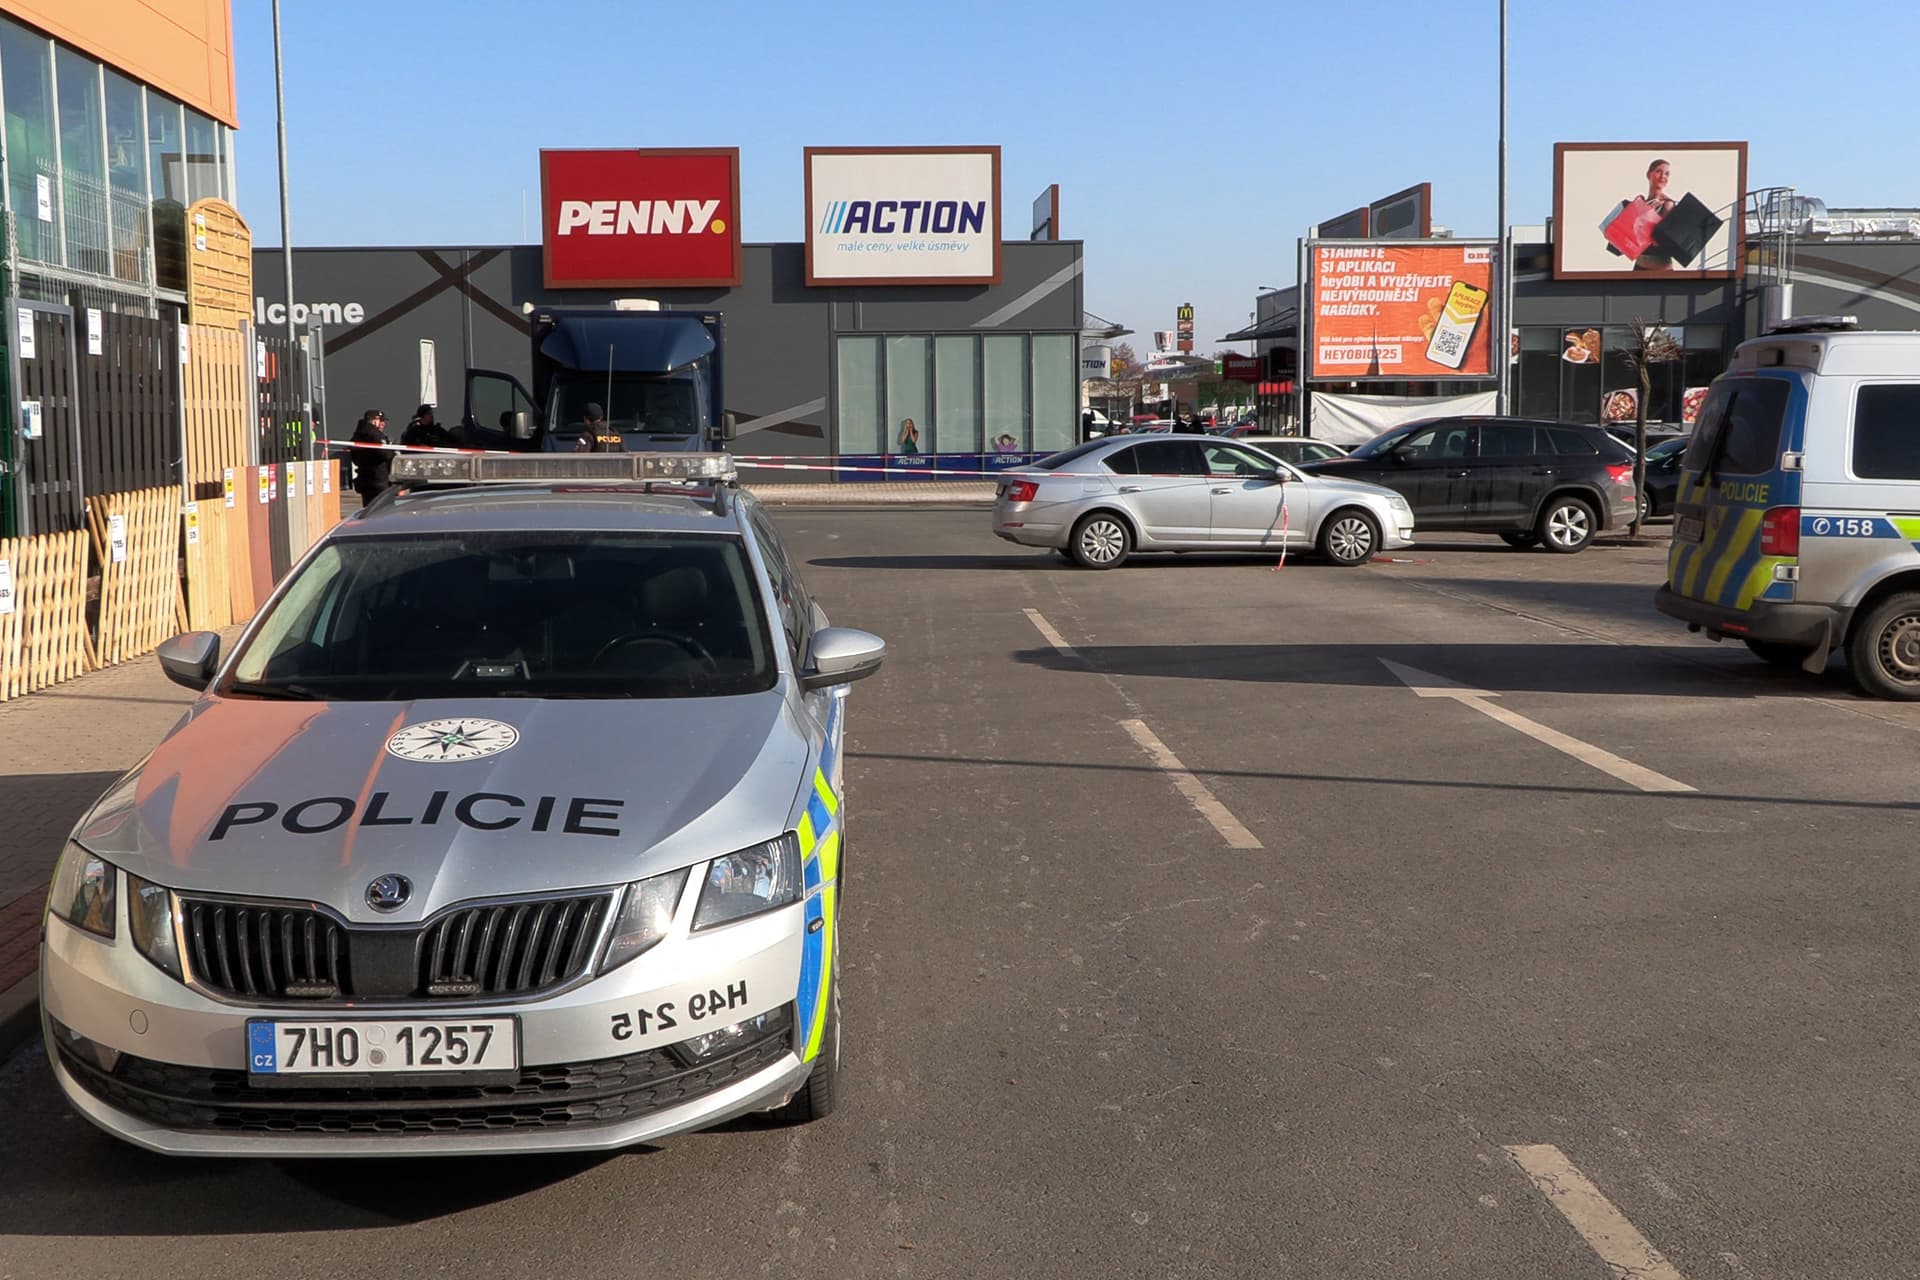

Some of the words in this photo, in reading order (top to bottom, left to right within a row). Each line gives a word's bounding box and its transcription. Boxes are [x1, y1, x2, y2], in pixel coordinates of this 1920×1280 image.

[842, 201, 986, 234] ACTION
[837, 240, 863, 251] malé
[866, 242, 893, 253] ceny,
[897, 240, 925, 251] velké
[928, 240, 969, 253] úsměvy
[1320, 260, 1334, 273] SI
[1337, 260, 1396, 273] APLIKACI
[1320, 275, 1365, 289] heyOBI
[1367, 275, 1376, 287] A
[1380, 273, 1453, 288] VYUŽÍVEJTE
[1321, 288, 1419, 302] NEJVÝHODNĚJŠÍ
[253, 296, 364, 324] lcome
[1320, 302, 1380, 316] NABÍDKY.
[1082, 360, 1106, 369] TION
[898, 457, 926, 465] ACTION
[994, 456, 1023, 464] ACTION
[1719, 481, 1770, 503] POLICIE
[1835, 519, 1873, 536] 158
[207, 791, 625, 842] POLICIE
[283, 1027, 359, 1067] 7H0
[396, 1024, 495, 1066] 1257
[254, 1054, 273, 1067] CZ
